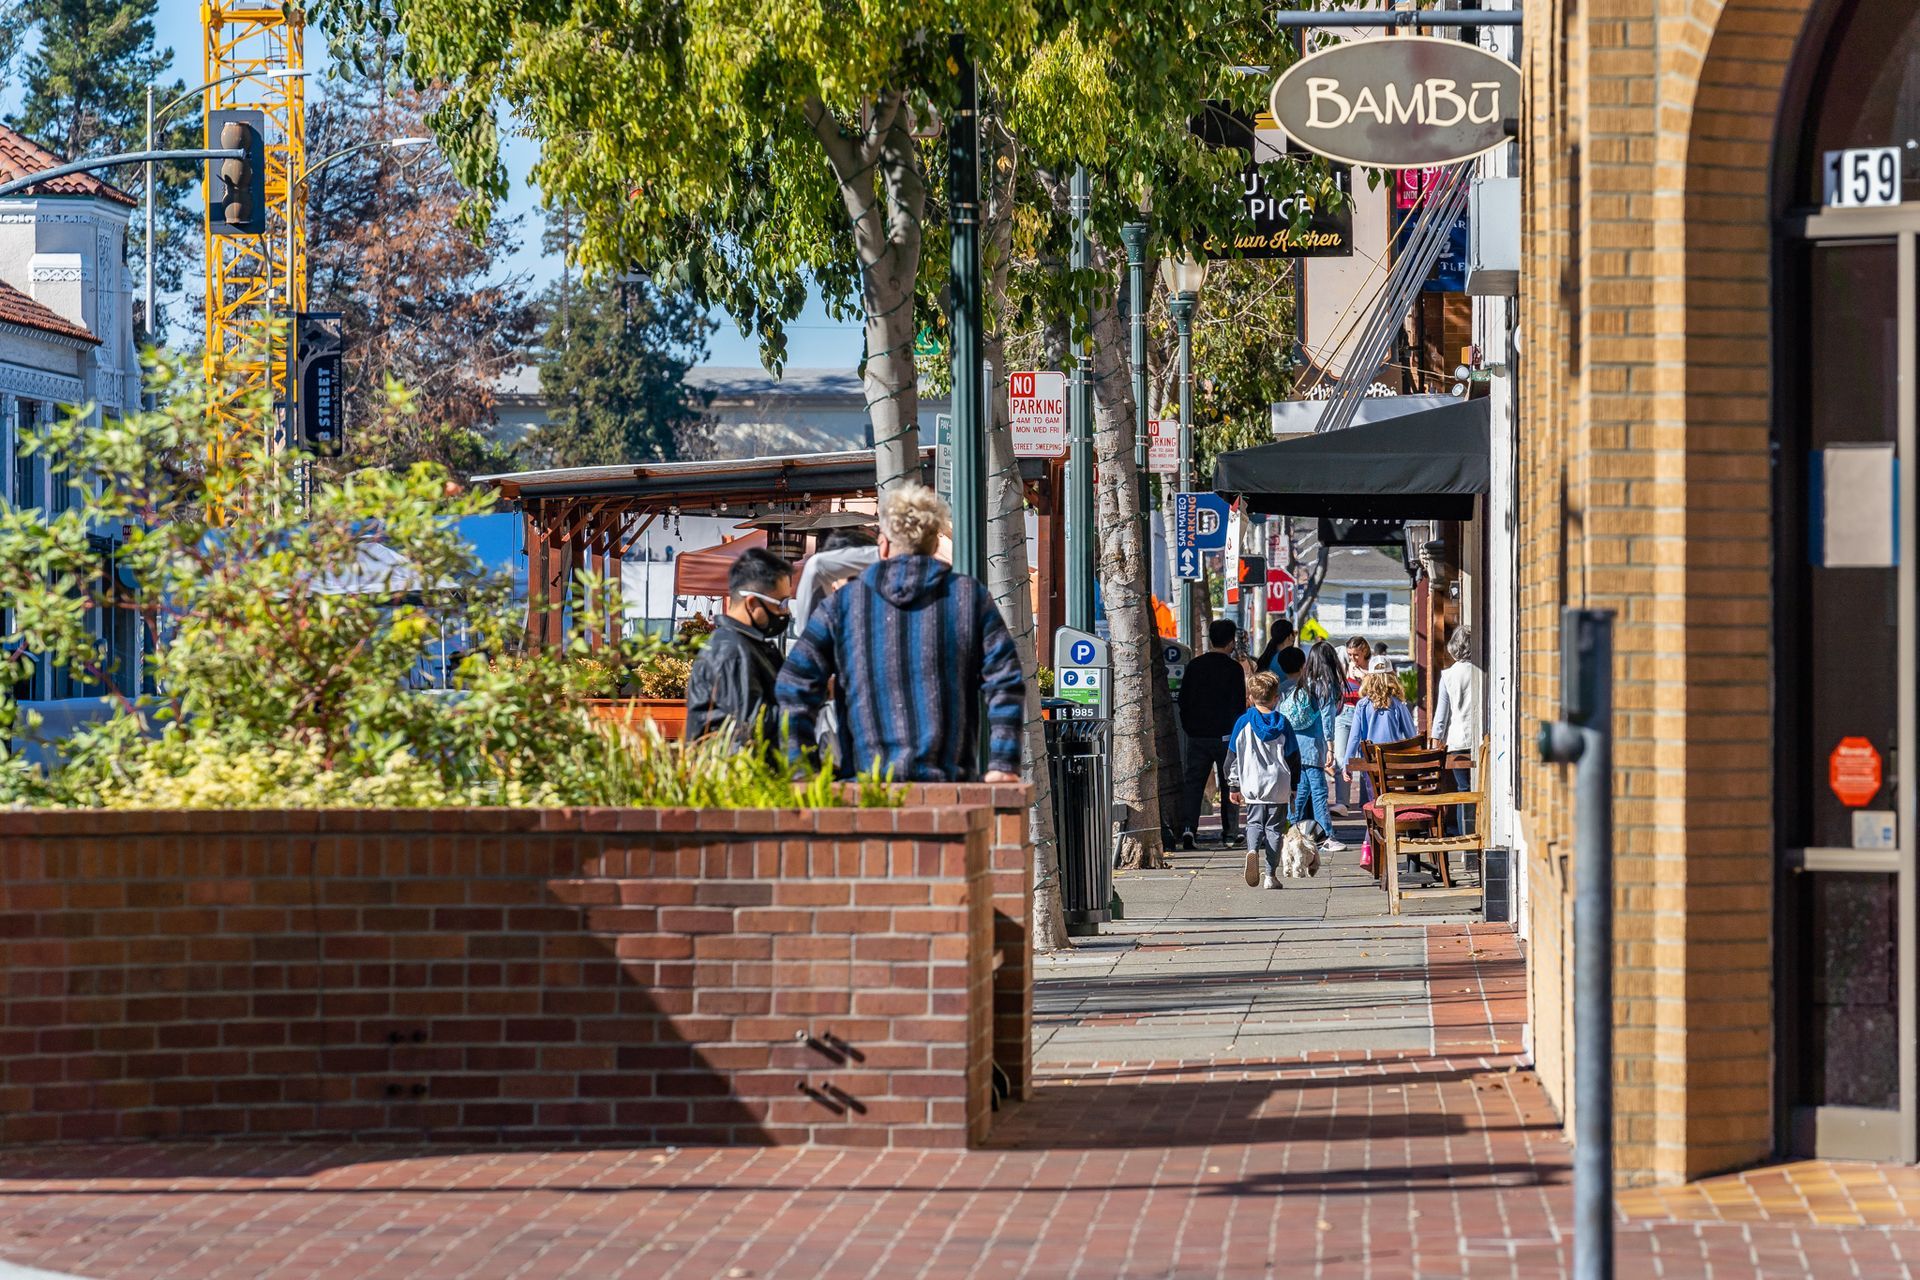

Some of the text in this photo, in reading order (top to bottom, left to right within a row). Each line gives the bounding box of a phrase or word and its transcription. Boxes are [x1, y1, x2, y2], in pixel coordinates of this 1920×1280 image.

[1831, 152, 1895, 204] 159
[1013, 376, 1032, 395] NO
[318, 367, 330, 427] STREET
[1012, 399, 1062, 415] PARKING
[1016, 416, 1030, 424] 4AM
[1033, 416, 1042, 424] TO
[1015, 426, 1060, 434] MON WED FRI
[1013, 443, 1062, 451] STREET SWEEPING
[1178, 497, 1187, 547] SAN MATEO
[1187, 495, 1197, 547] PARKING
[1077, 644, 1091, 661] P
[1168, 648, 1178, 660] P
[1067, 674, 1075, 683] P
